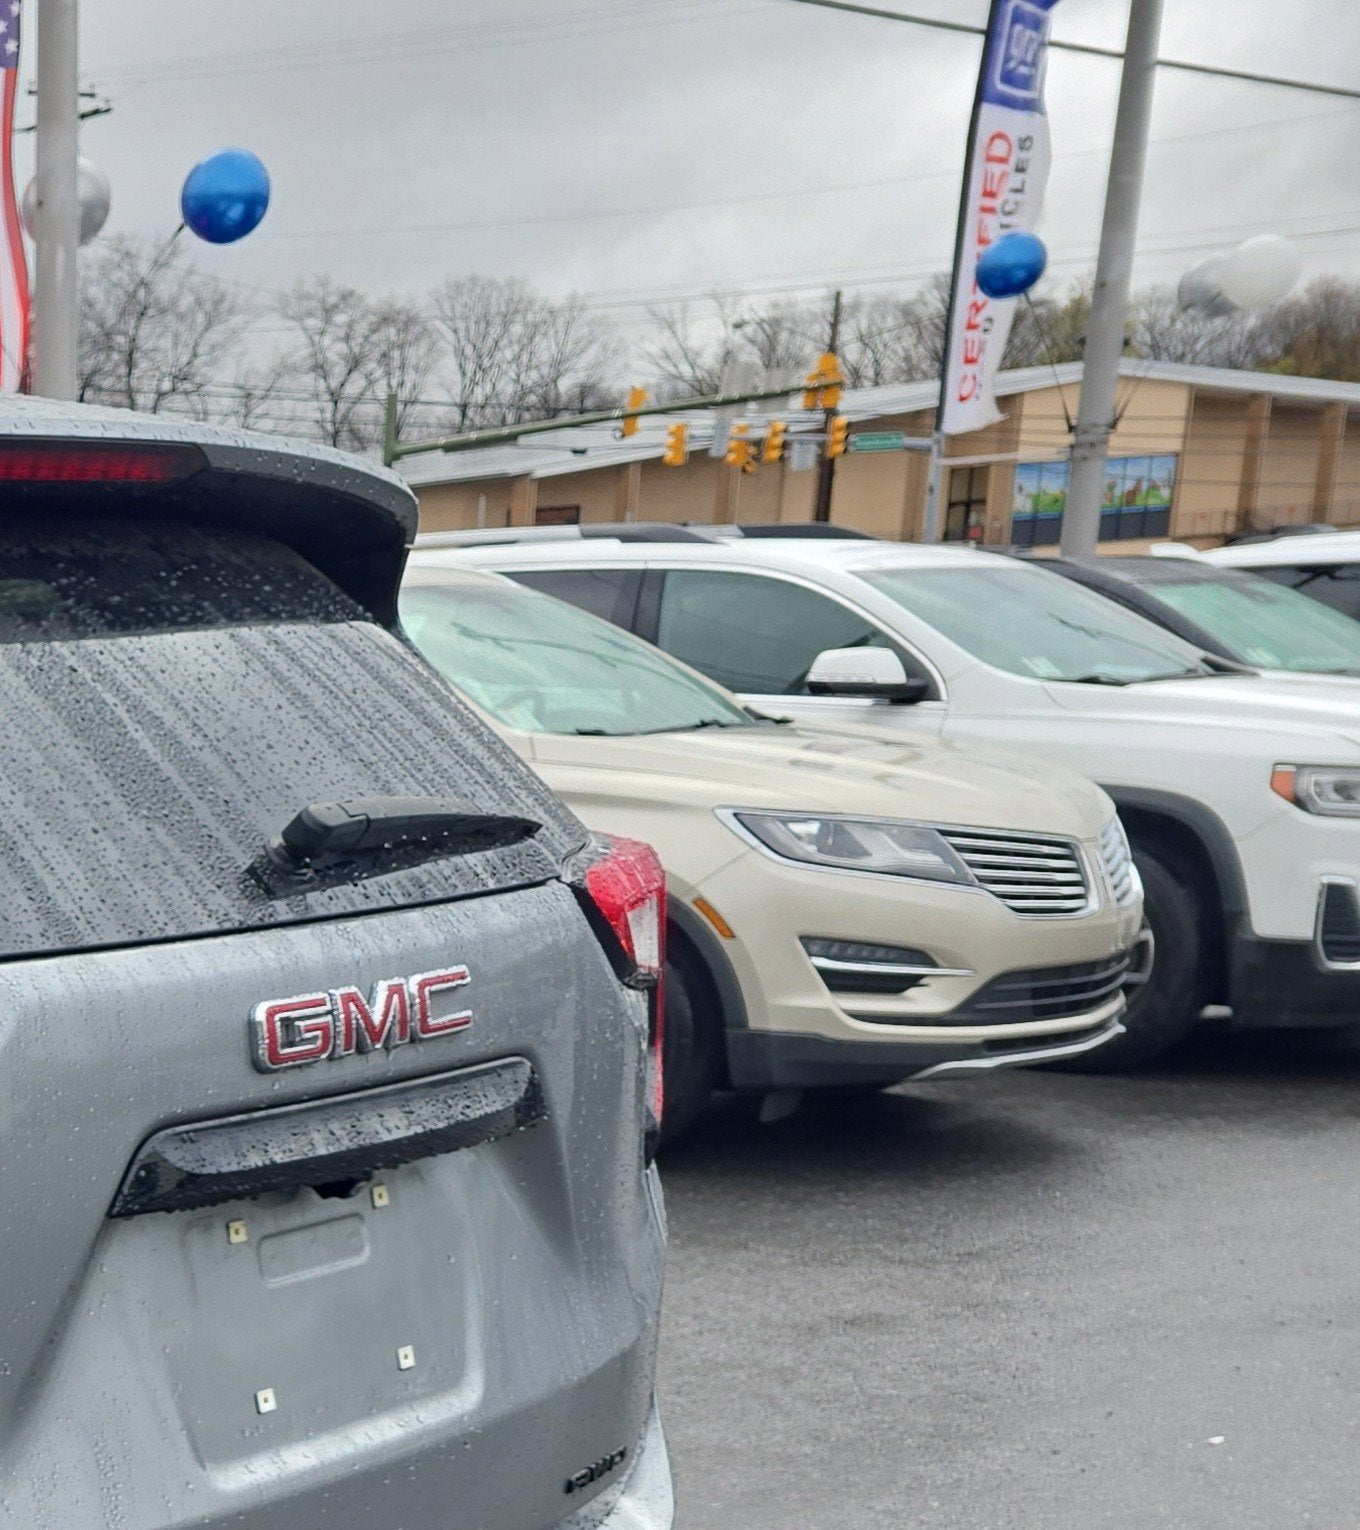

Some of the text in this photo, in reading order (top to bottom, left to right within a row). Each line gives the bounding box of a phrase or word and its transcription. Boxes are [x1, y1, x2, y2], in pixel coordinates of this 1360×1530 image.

[998, 134, 1035, 231] ICLES
[957, 129, 1013, 403] CERFIED
[250, 963, 474, 1074] GMC
